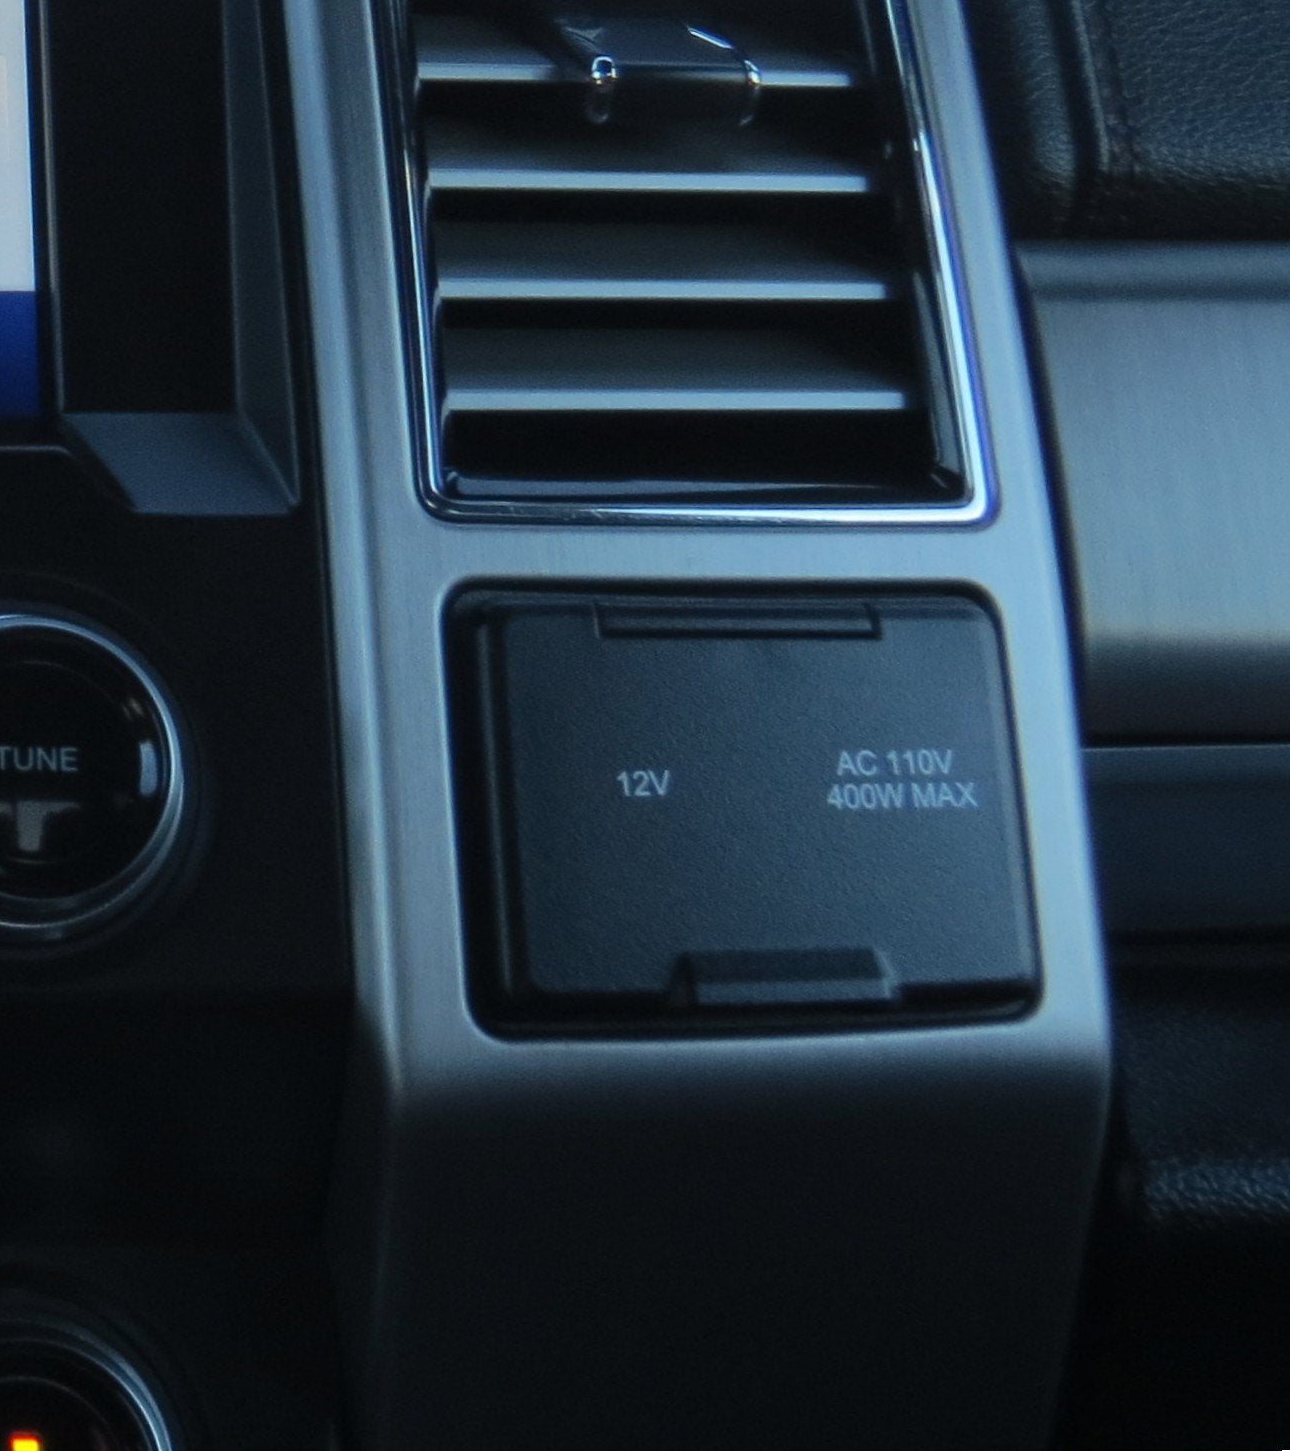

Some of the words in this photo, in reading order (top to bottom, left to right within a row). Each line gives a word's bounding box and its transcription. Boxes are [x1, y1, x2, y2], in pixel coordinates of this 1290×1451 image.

[836, 750, 877, 776] AC
[886, 749, 954, 776] 110V
[617, 770, 671, 797] 12V
[826, 783, 903, 810] 400W
[911, 782, 979, 808] MAX
